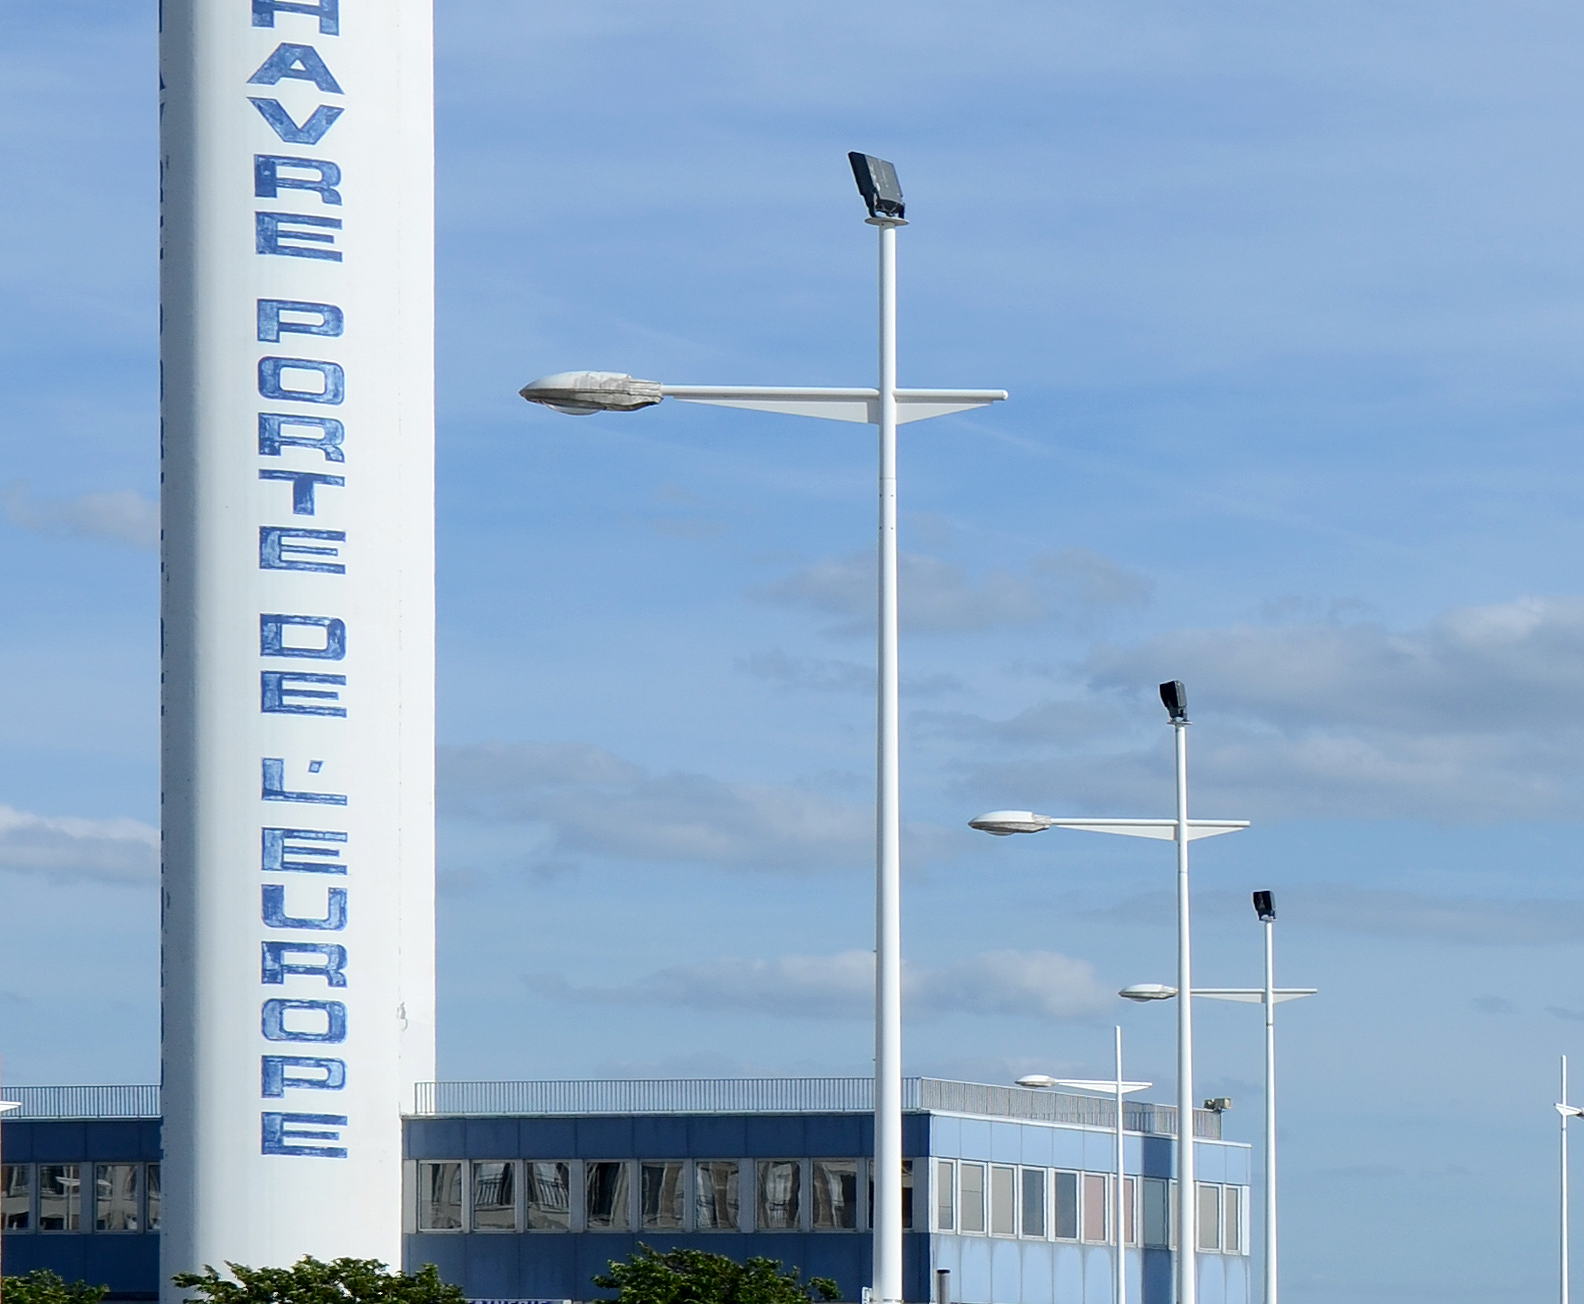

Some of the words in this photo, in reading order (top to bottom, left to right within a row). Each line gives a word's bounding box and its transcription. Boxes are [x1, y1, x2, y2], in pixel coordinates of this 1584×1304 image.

[257, 298, 346, 575] PORTE
[260, 613, 347, 719] DE
[261, 756, 348, 1159] L'EUROPE
